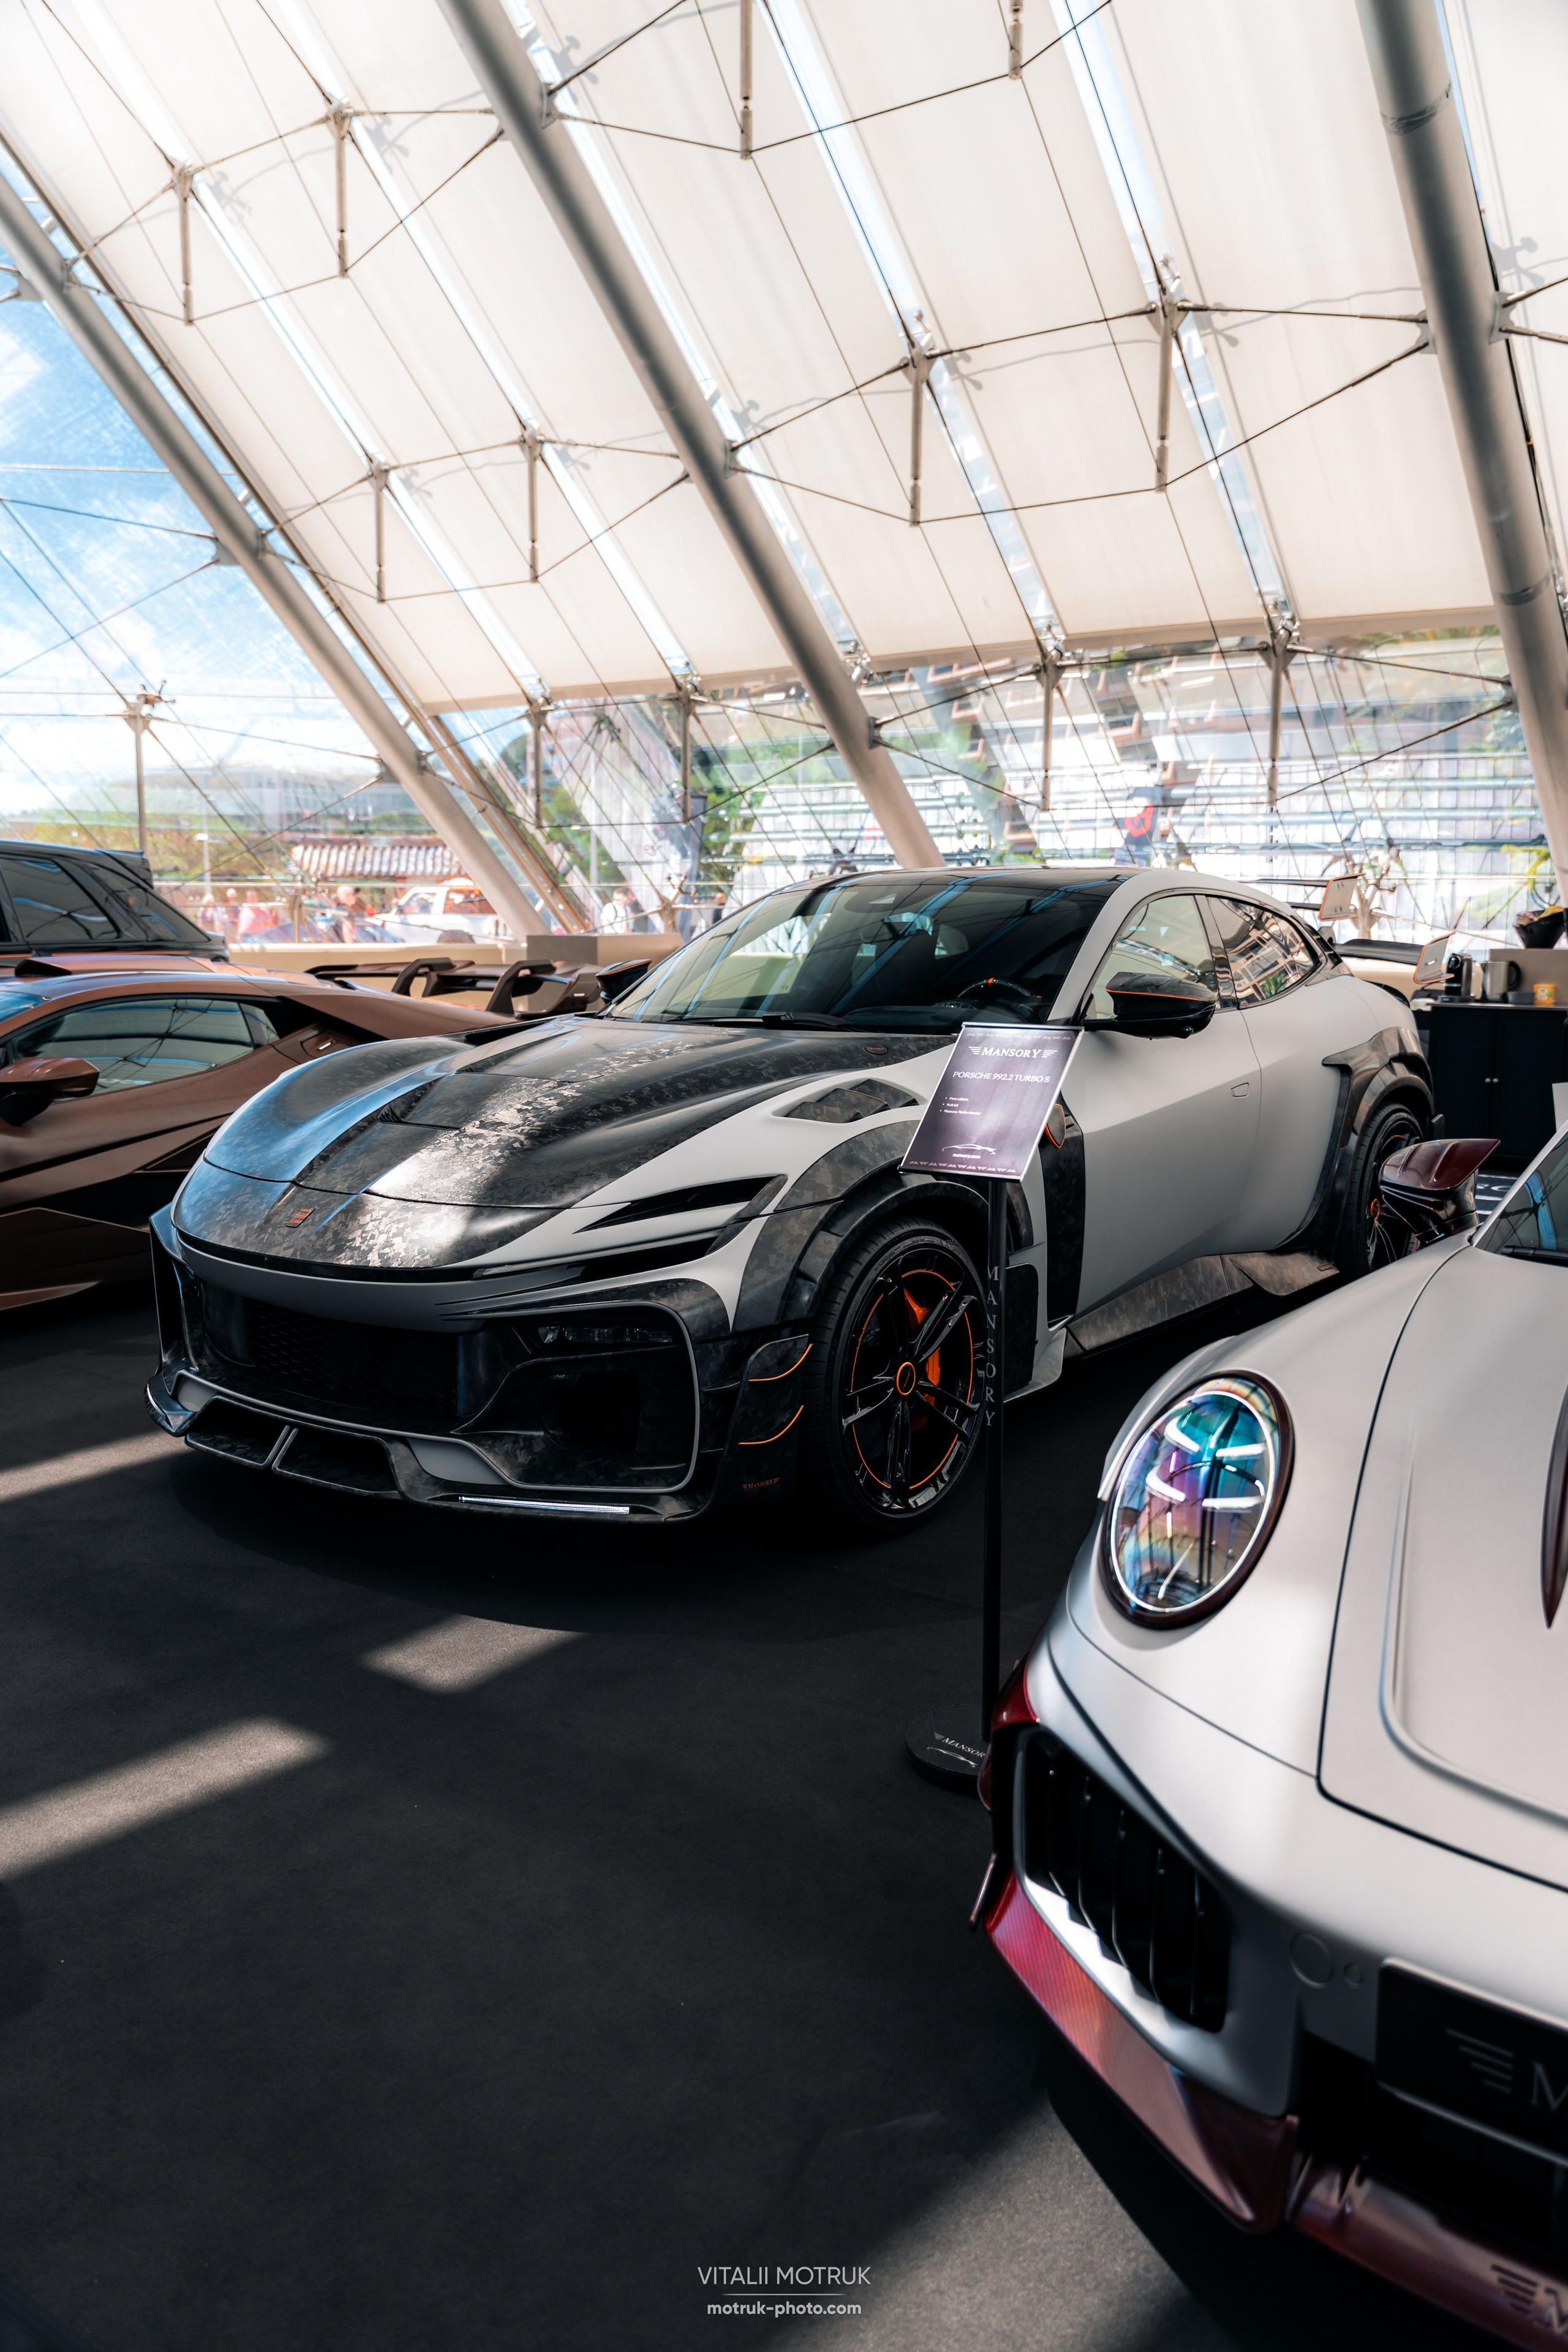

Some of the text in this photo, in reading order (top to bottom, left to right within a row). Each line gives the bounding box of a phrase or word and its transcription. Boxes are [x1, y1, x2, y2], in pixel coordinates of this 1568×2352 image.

[981, 1047, 1042, 1058] MANSORY
[952, 1071, 992, 1080] PORSCHE
[986, 1266, 1000, 1426] MANSORY
[747, 1479, 774, 1489] MANSORY
[942, 1738, 986, 1757] MANSOR
